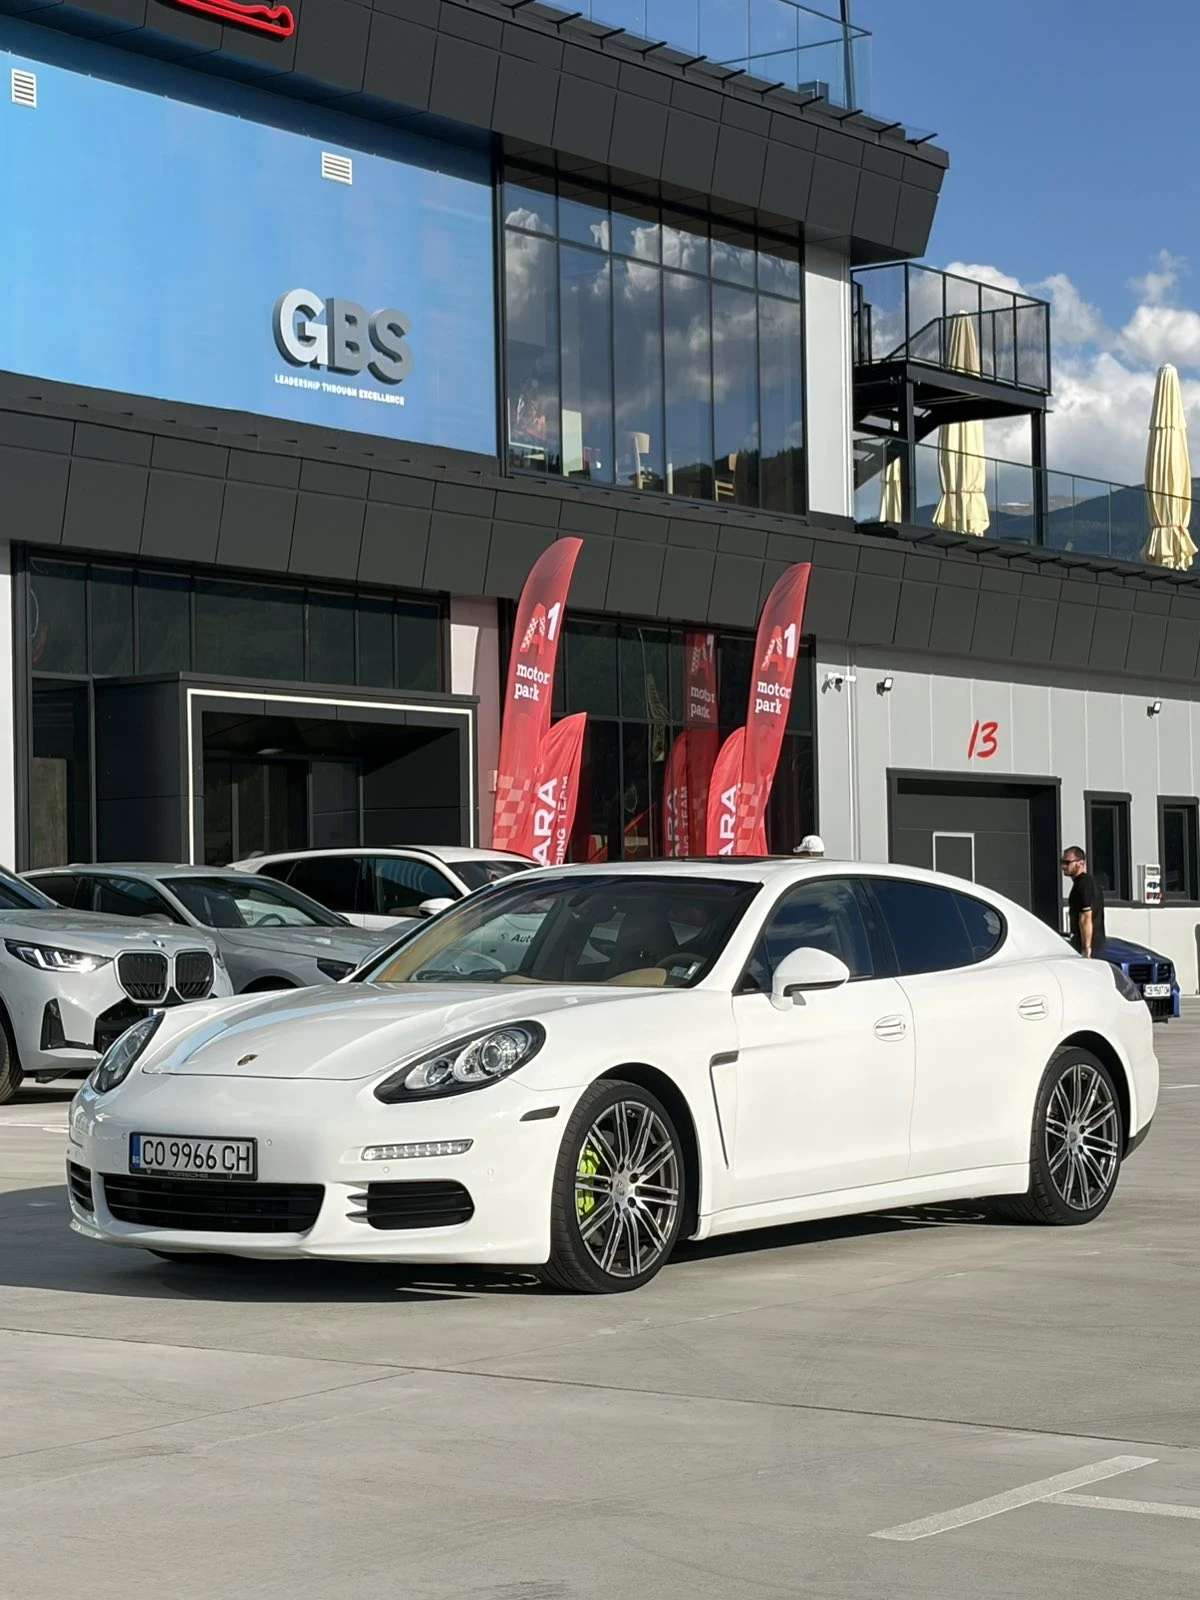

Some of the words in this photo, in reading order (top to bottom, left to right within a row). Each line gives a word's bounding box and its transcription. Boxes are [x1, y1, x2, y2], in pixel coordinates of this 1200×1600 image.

[272, 288, 414, 386] GBS
[275, 374, 320, 391] LEADERSHIP
[321, 381, 357, 398] THROUGH
[358, 389, 404, 406] EXCELLENCE
[516, 664, 550, 684] motor
[514, 683, 540, 701] park
[757, 681, 792, 699] motor
[755, 698, 782, 714] park
[967, 719, 999, 760] 13
[143, 1140, 165, 1166] CO
[169, 1142, 217, 1170] 9966
[222, 1145, 250, 1172] CH
